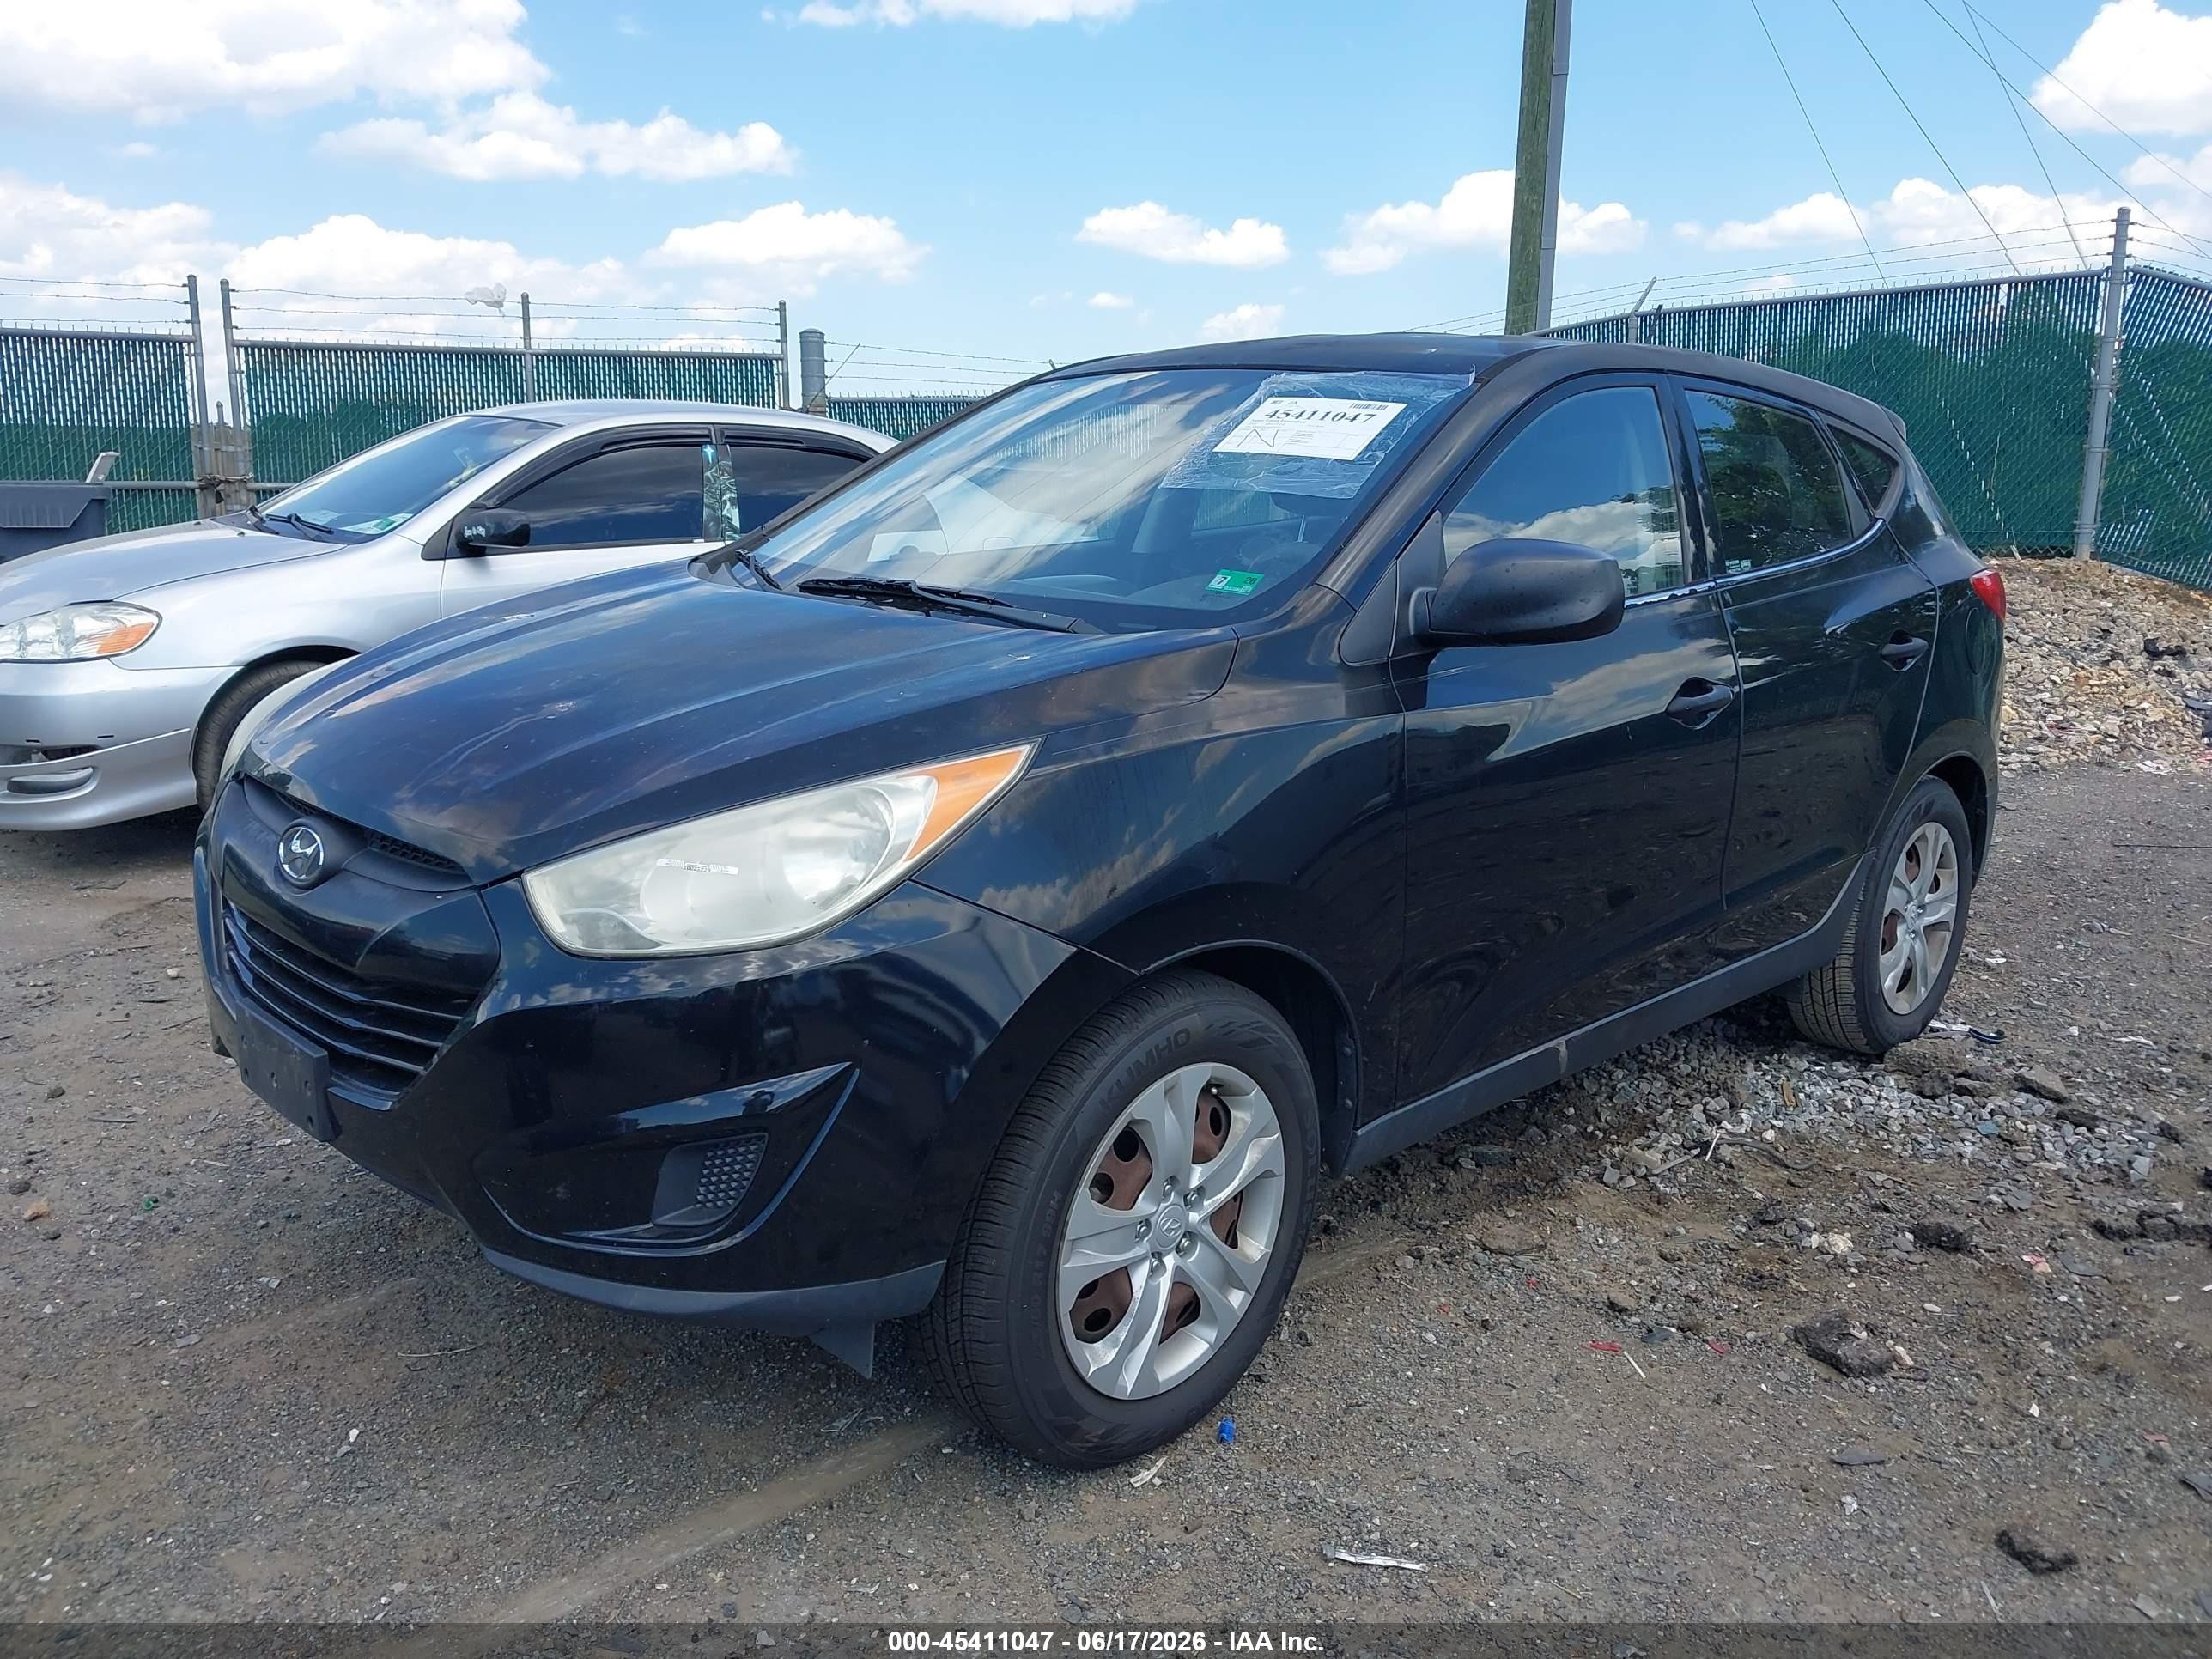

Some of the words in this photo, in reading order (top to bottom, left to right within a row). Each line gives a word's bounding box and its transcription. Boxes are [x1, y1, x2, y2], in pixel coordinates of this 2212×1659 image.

[1264, 409, 1378, 424] 45411047
[1216, 576, 1227, 586] 7
[1098, 1027, 1191, 1113] KUMHO
